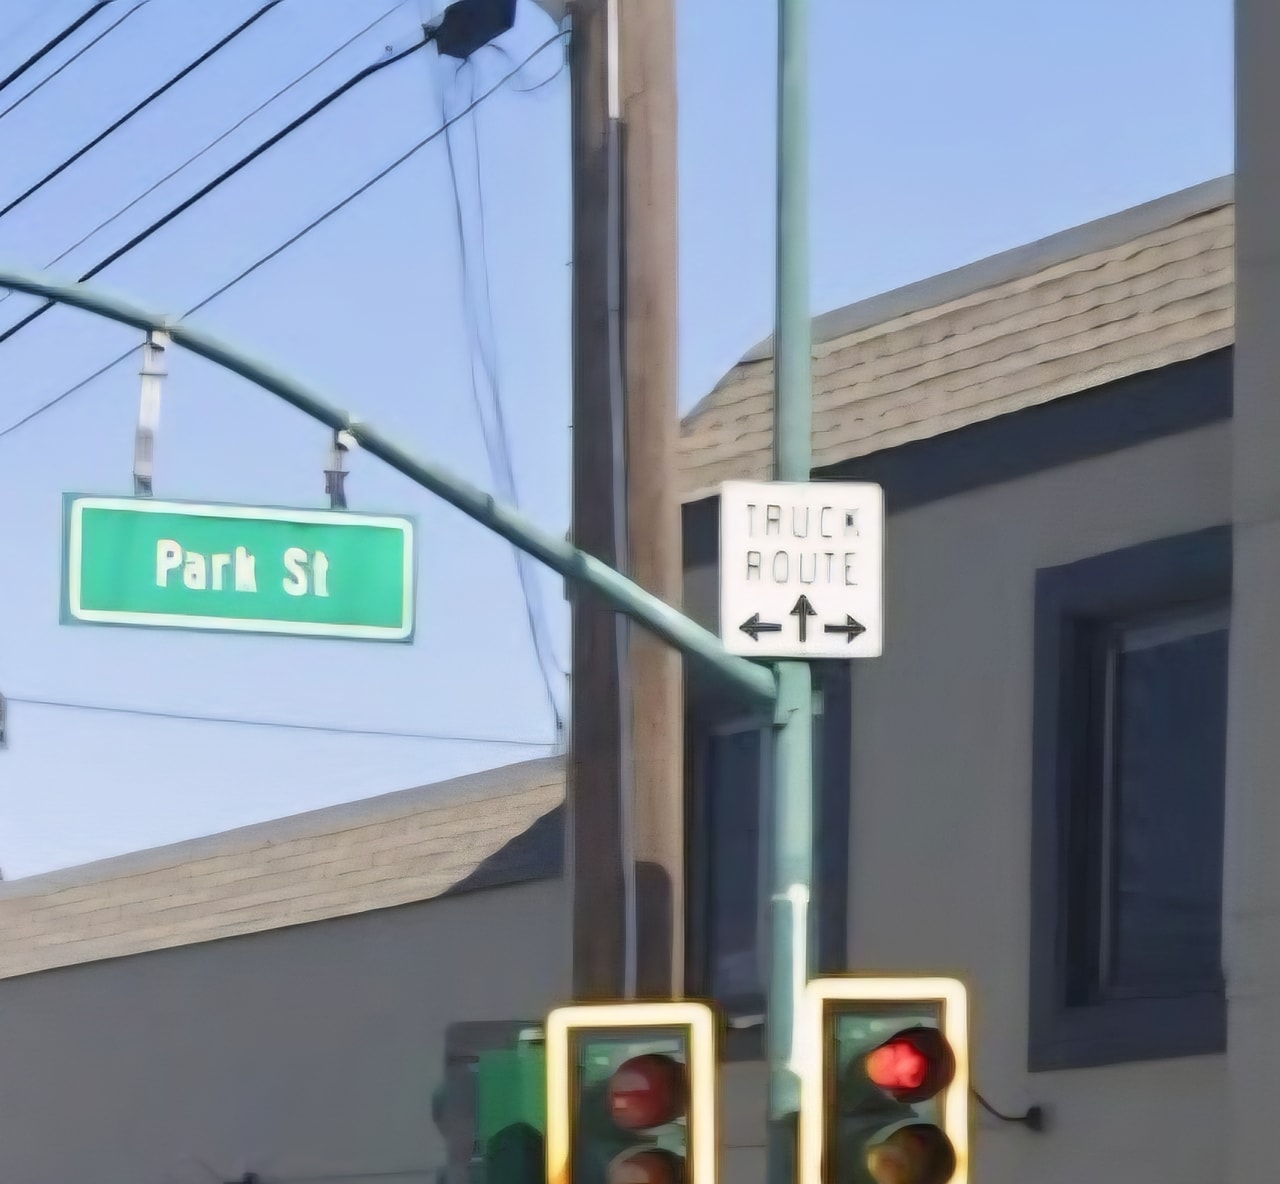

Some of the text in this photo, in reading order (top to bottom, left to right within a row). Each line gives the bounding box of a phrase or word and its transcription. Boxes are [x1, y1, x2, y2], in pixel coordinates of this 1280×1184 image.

[746, 503, 861, 539] TRUCK
[155, 538, 330, 597] Park St
[745, 550, 859, 587] ROUTE
